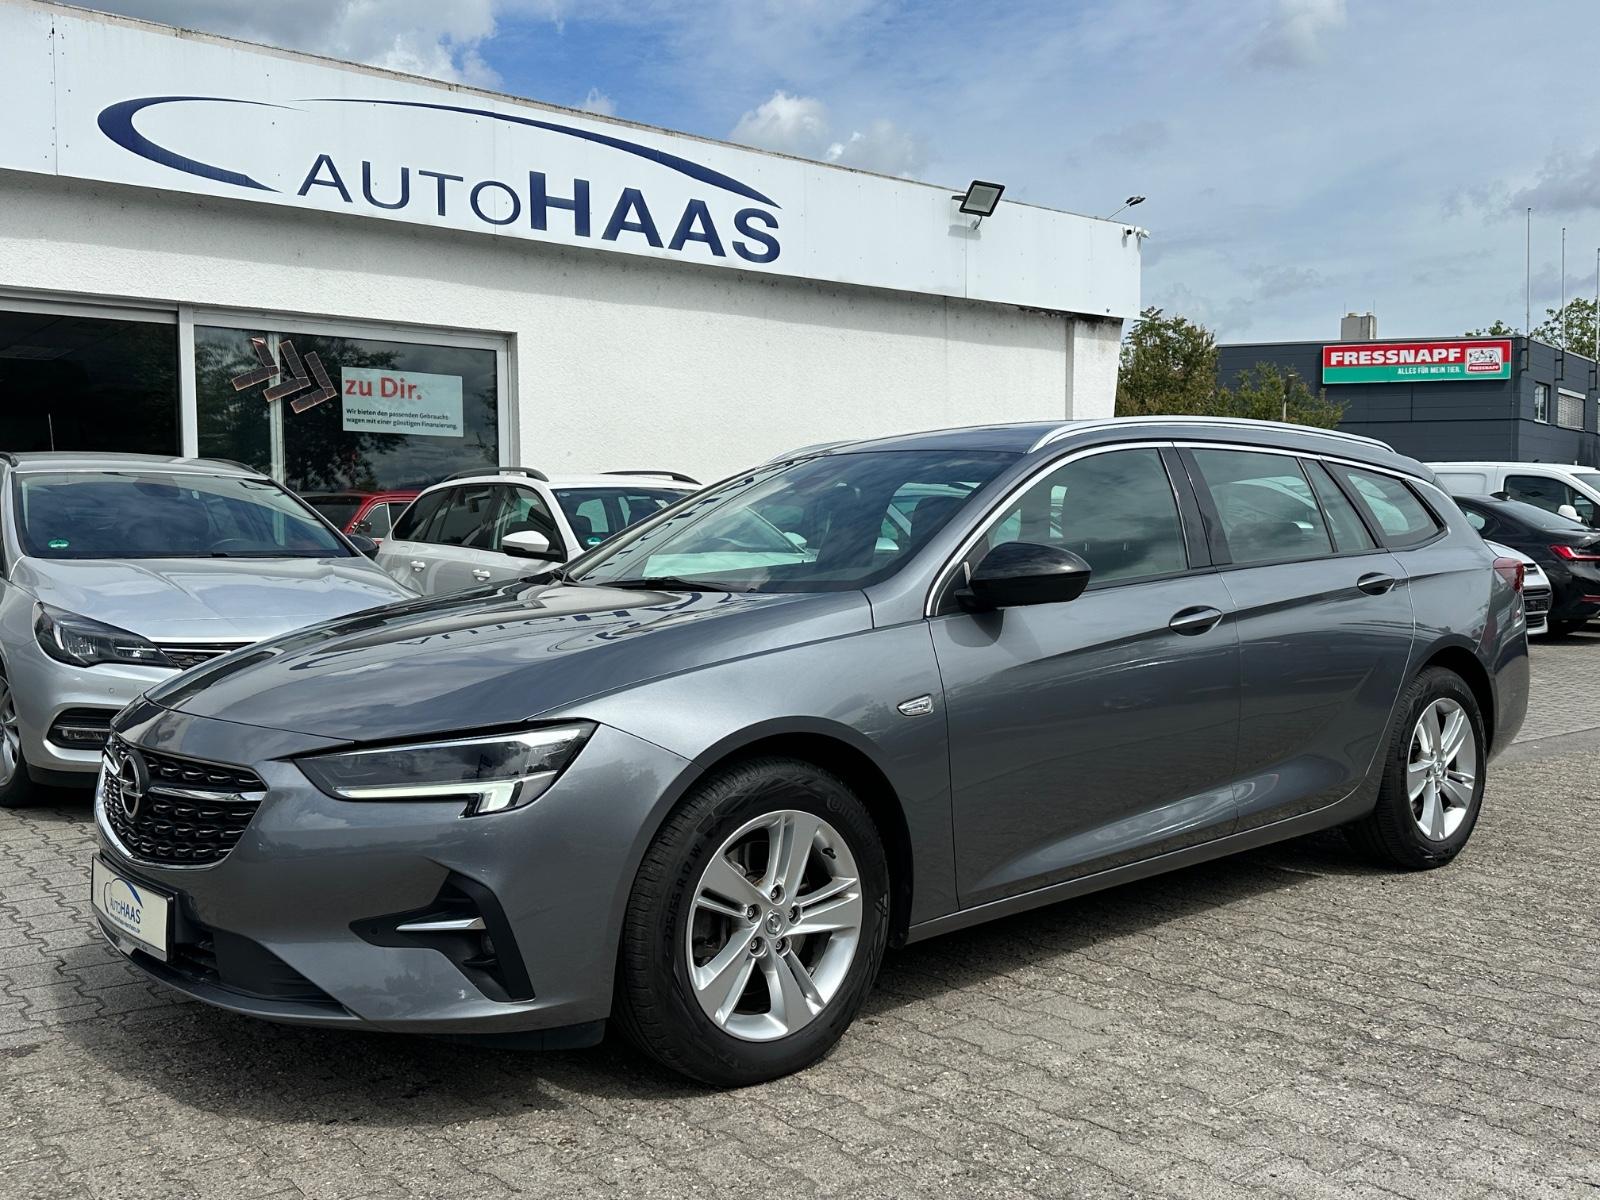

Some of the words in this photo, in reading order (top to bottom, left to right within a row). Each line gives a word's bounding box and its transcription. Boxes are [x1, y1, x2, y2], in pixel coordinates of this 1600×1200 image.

[1330, 348, 1461, 365] FRESSNAPF
[1397, 367, 1416, 375] ALLES
[1418, 366, 1429, 374] FÜR
[1430, 366, 1445, 374] MEIN
[345, 379, 372, 397] zu
[380, 377, 422, 400] Dir.
[357, 408, 377, 416] bieten
[388, 411, 419, 420] passenden
[346, 417, 366, 425] wagen
[392, 419, 421, 428] günstigen
